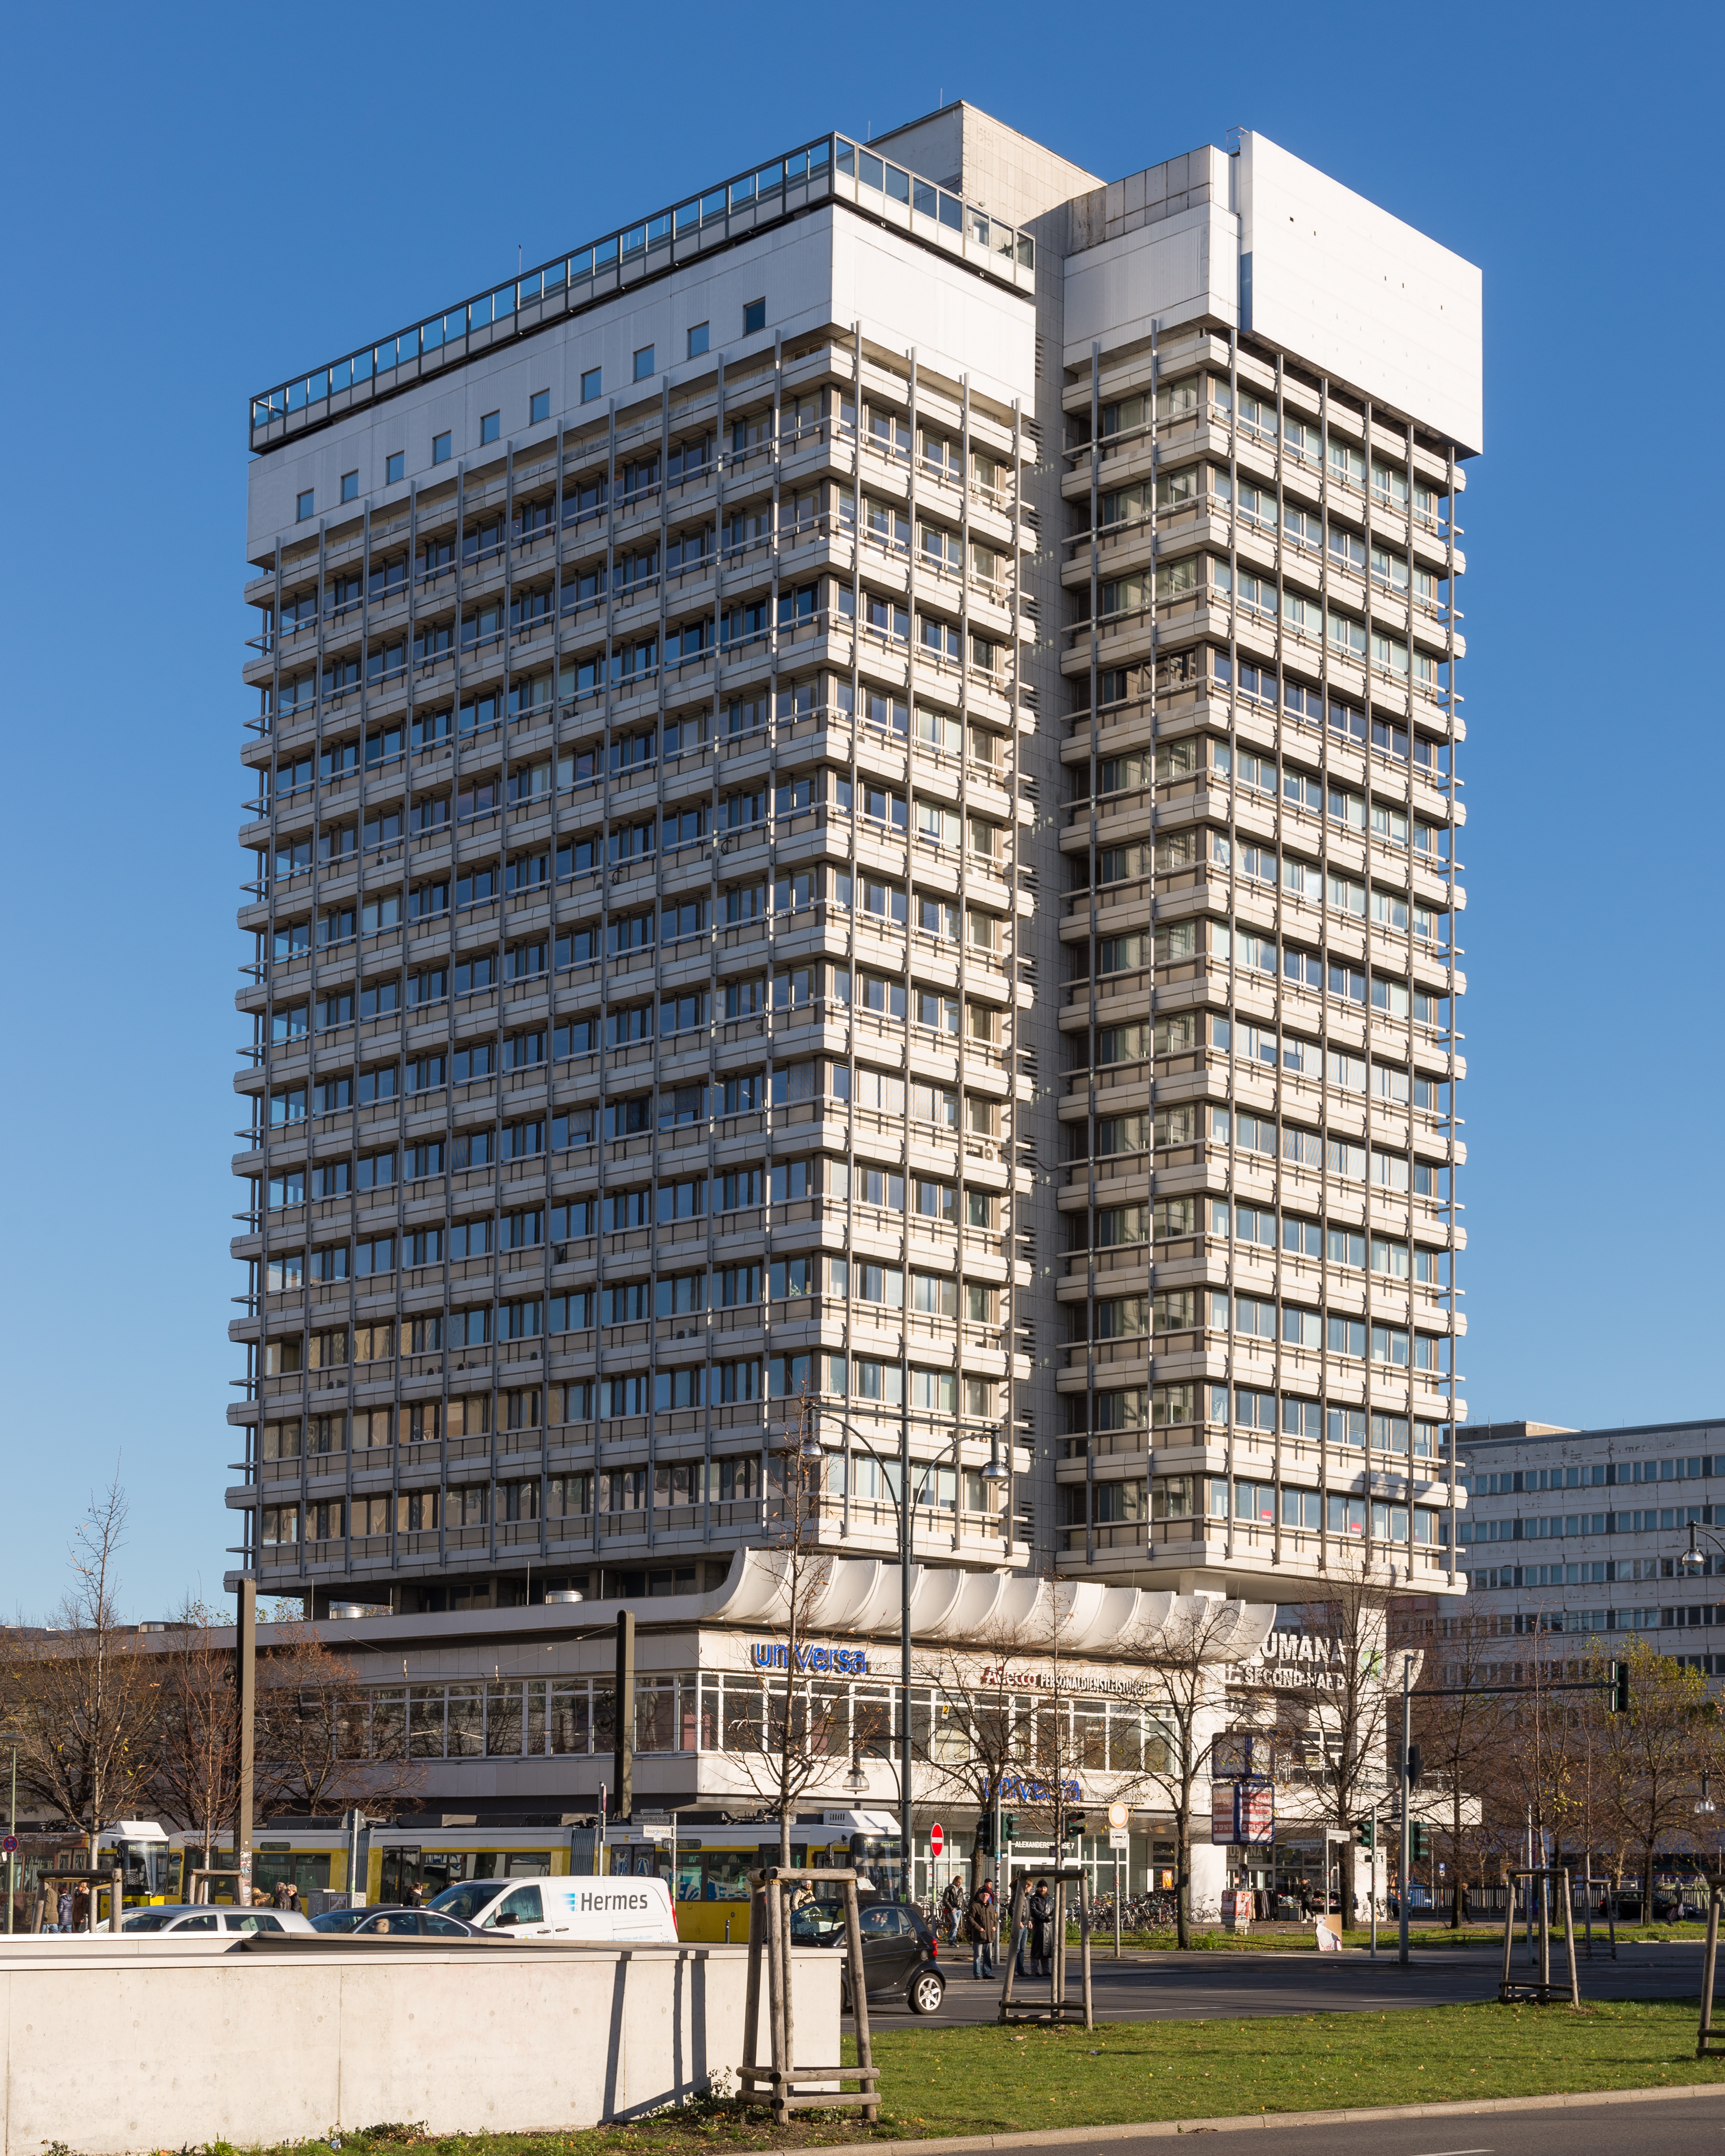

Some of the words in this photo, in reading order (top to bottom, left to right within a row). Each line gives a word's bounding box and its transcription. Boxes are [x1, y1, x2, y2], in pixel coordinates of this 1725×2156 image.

[752, 1643, 866, 1674] unVersa
[1261, 1632, 1346, 1664] UMANA
[943, 1706, 948, 1715] 2
[984, 1776, 1079, 1801] uniVea
[1015, 1841, 1070, 1849] ALEXANDERSSE
[581, 1892, 648, 1912] Hermes
